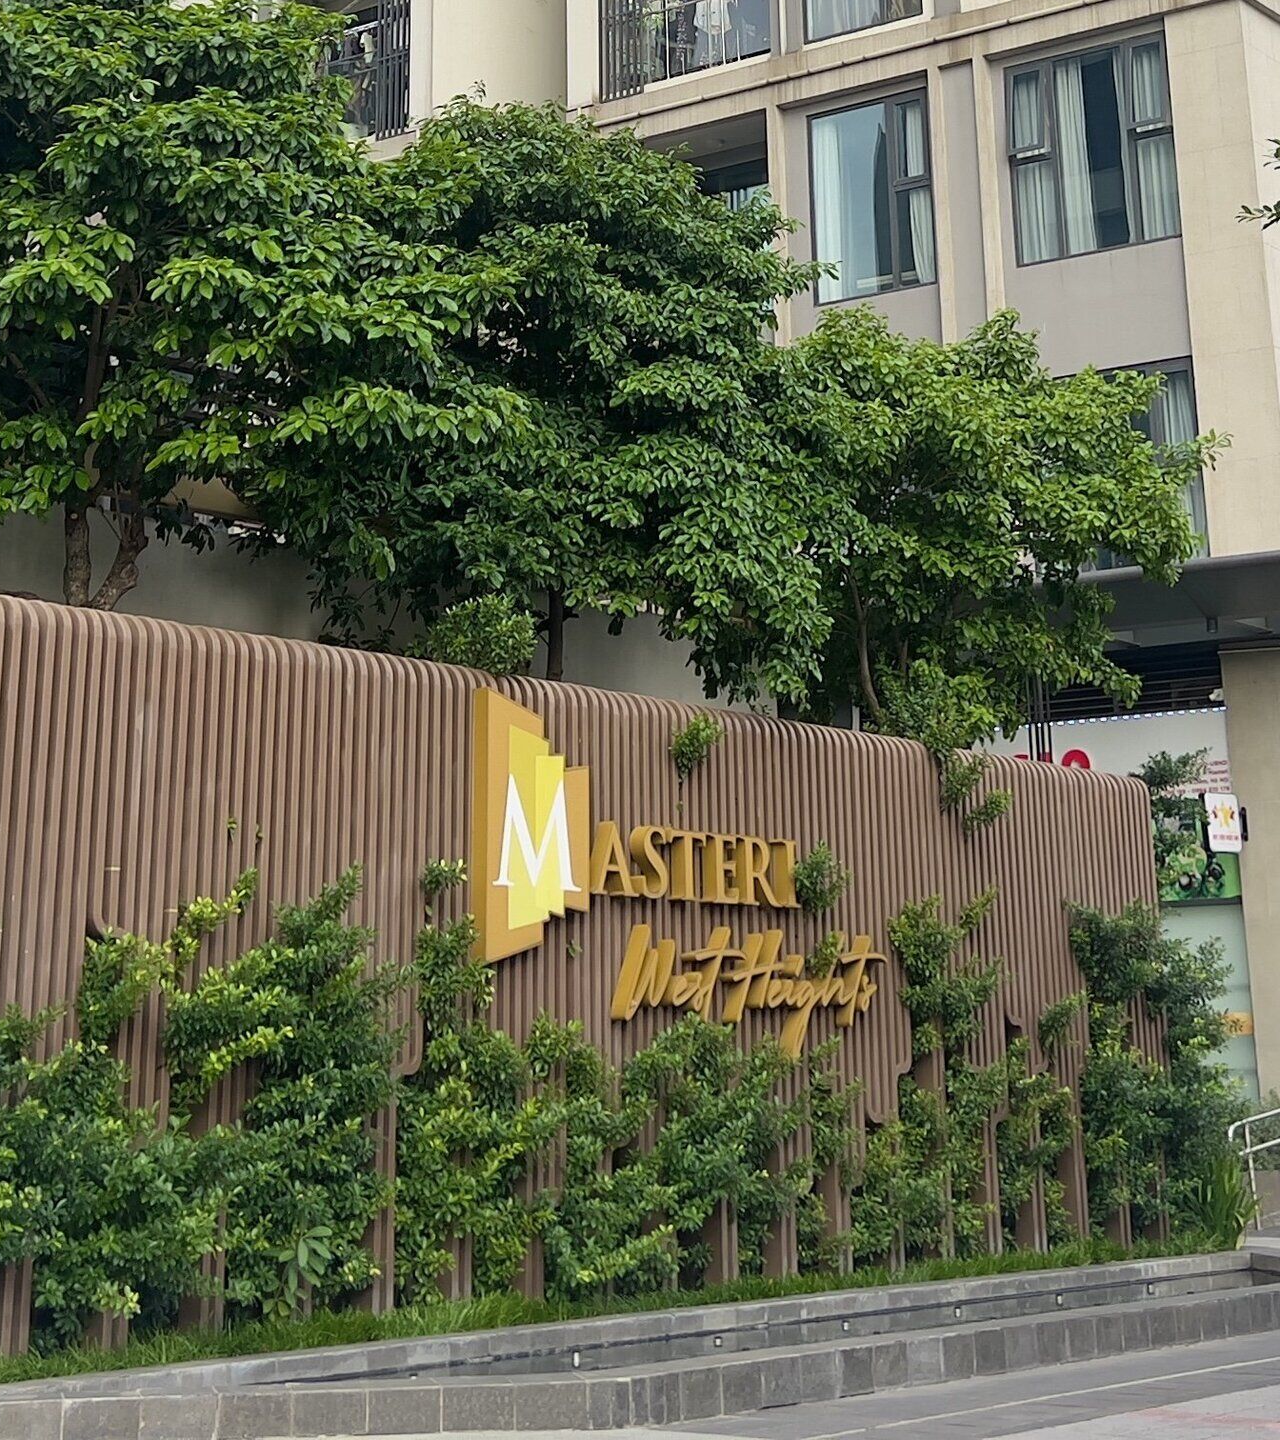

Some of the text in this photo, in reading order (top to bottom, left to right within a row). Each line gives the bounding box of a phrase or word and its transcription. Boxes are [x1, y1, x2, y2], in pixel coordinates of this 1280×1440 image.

[493, 772, 802, 909] MASTERI
[610, 923, 889, 1060] West Heights
